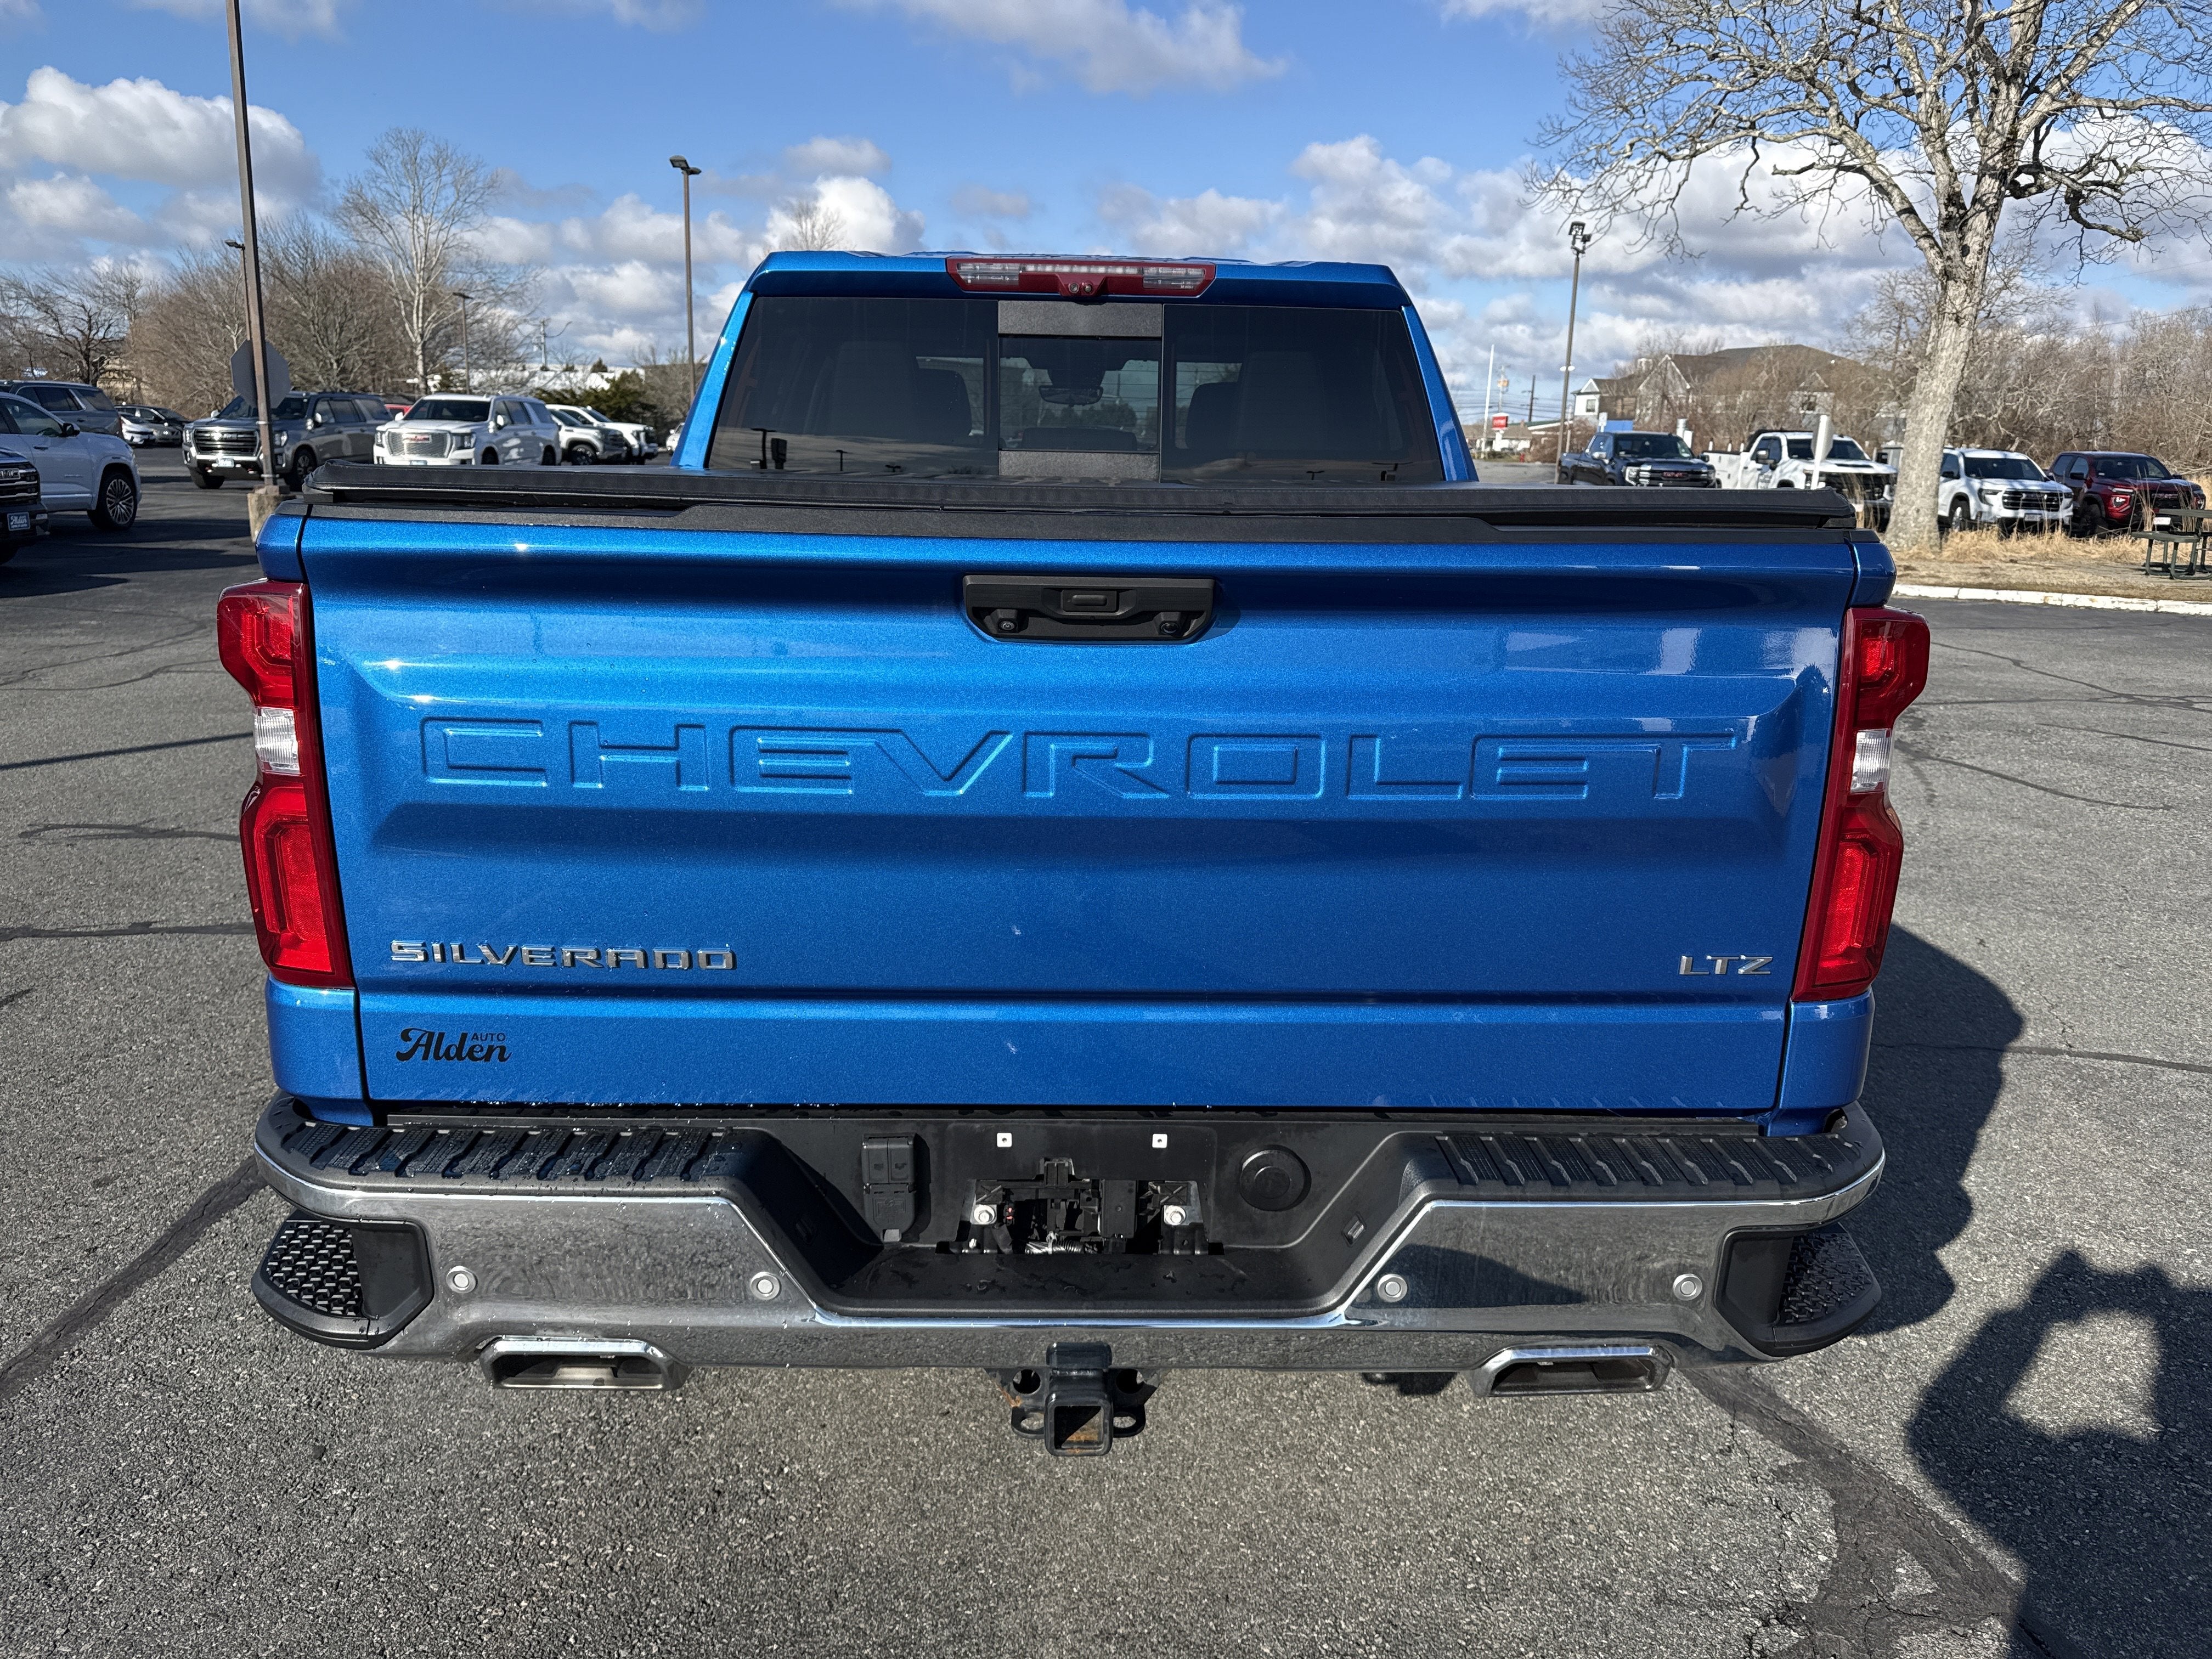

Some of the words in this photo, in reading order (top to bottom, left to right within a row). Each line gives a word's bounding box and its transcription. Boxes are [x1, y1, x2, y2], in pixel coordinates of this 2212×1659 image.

[420, 716, 1736, 800] CHEVROLET
[390, 939, 737, 970] SILVERADO
[1679, 955, 1773, 975] LTZ
[396, 1028, 512, 1063] Alden
[471, 1032, 506, 1041] AUTO
